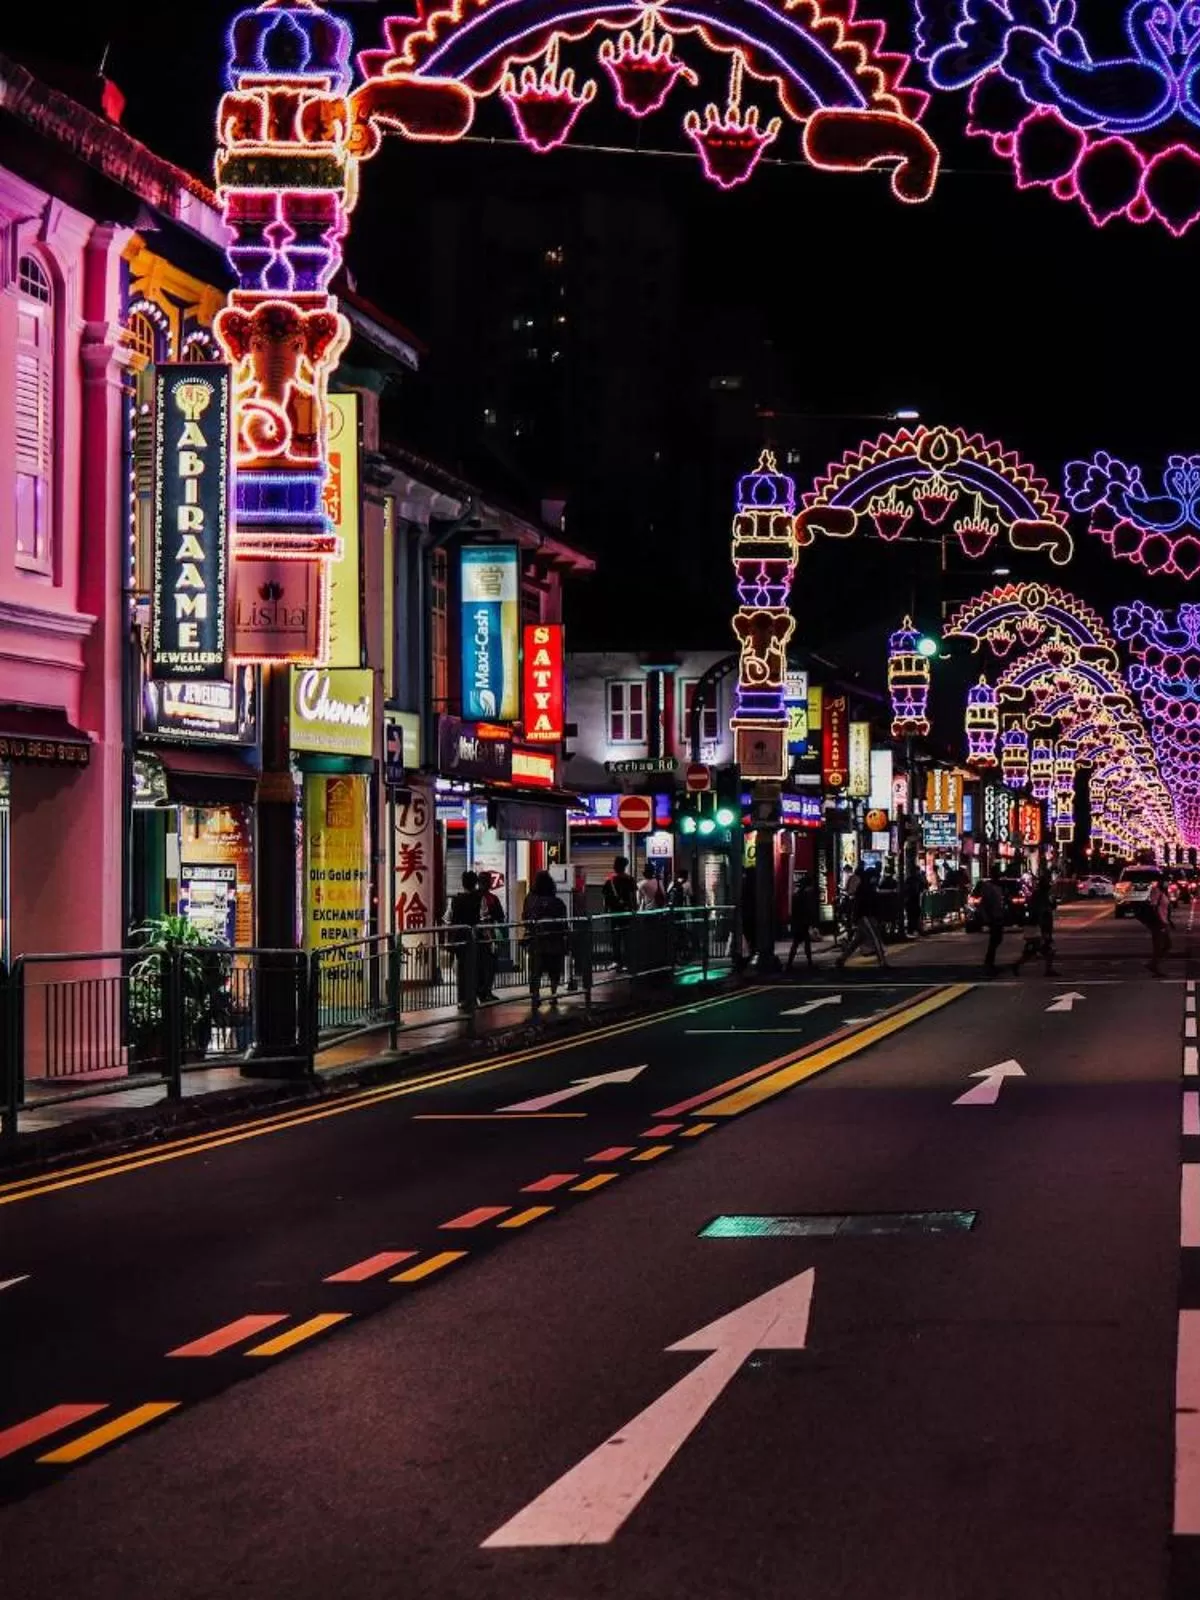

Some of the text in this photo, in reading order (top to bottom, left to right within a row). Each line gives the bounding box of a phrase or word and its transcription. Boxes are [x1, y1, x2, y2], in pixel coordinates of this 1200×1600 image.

[175, 422, 208, 648] ABIRAAME
[237, 600, 305, 627] Lisha
[154, 652, 223, 664] JEWELLERS
[474, 609, 489, 688] Maxi-Cash
[532, 627, 553, 731] SATYA
[607, 760, 673, 772] Kerbau Rd
[399, 799, 426, 828] 75
[310, 869, 326, 880] Old
[328, 869, 351, 880] Gold
[321, 928, 358, 940] REPAIR
